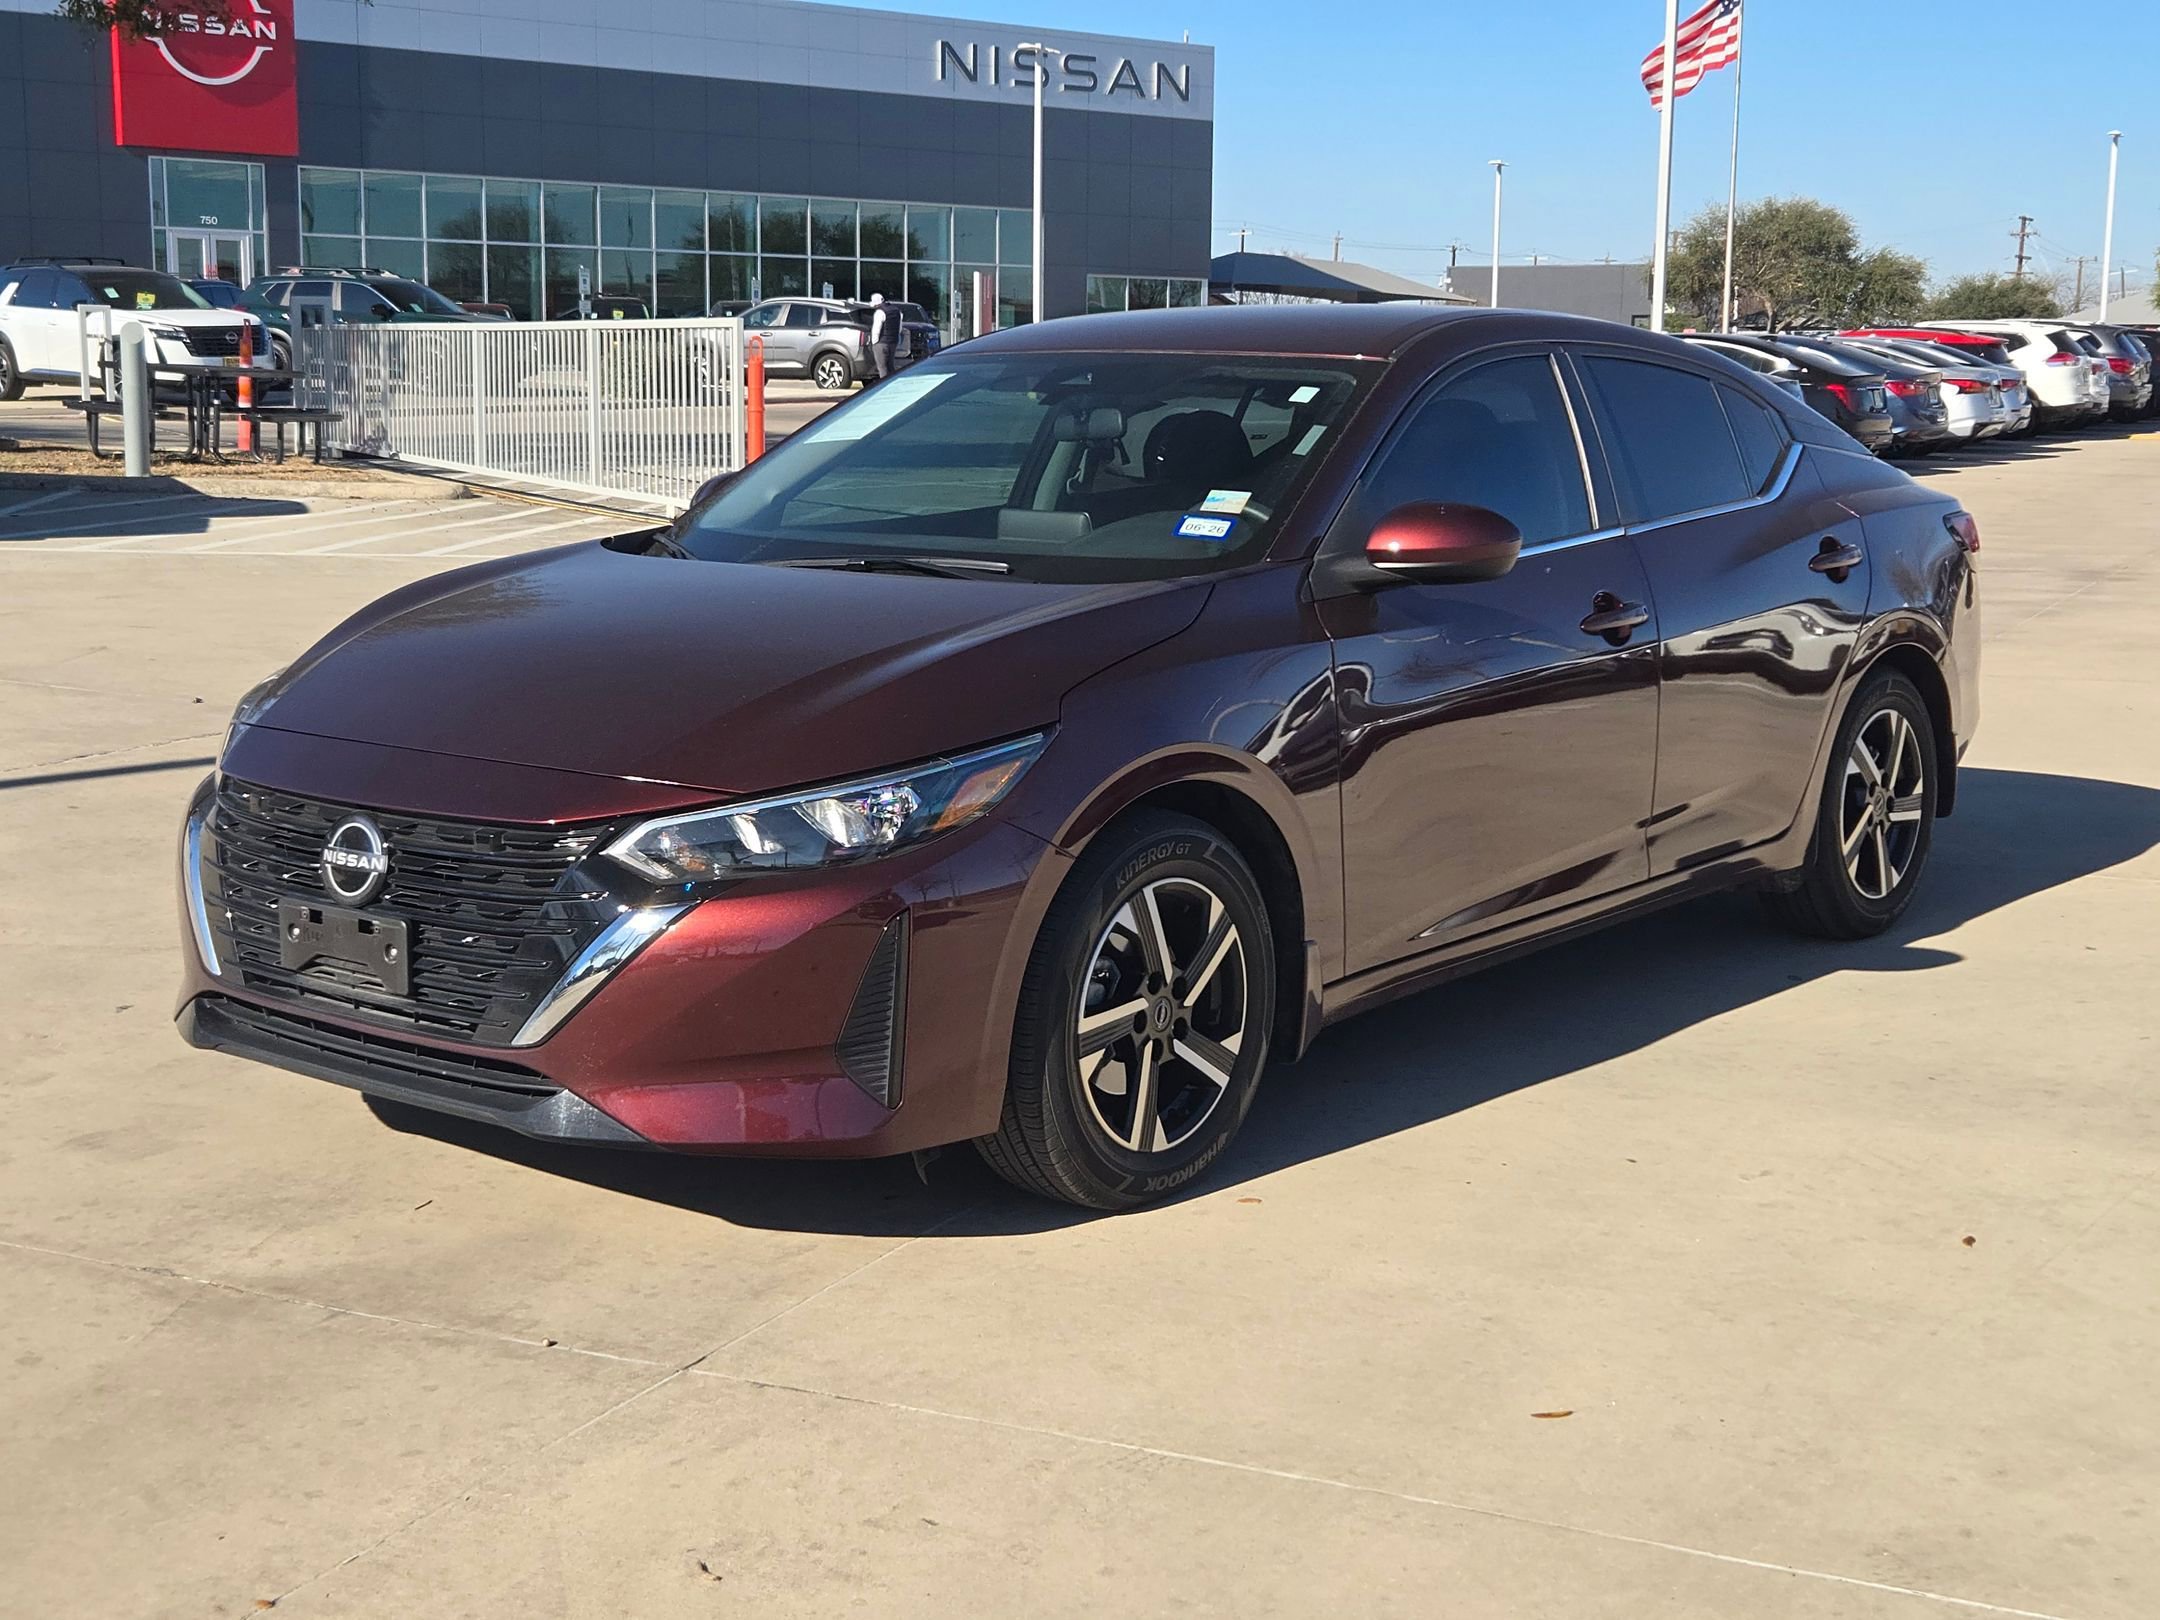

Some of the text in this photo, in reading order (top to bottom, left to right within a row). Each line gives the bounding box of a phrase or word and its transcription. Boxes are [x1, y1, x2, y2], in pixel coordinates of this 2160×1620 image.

[936, 39, 1191, 102] NISSAN
[199, 215, 218, 226] 750
[1176, 843, 1192, 855] GT
[323, 848, 386, 871] NISSAN
